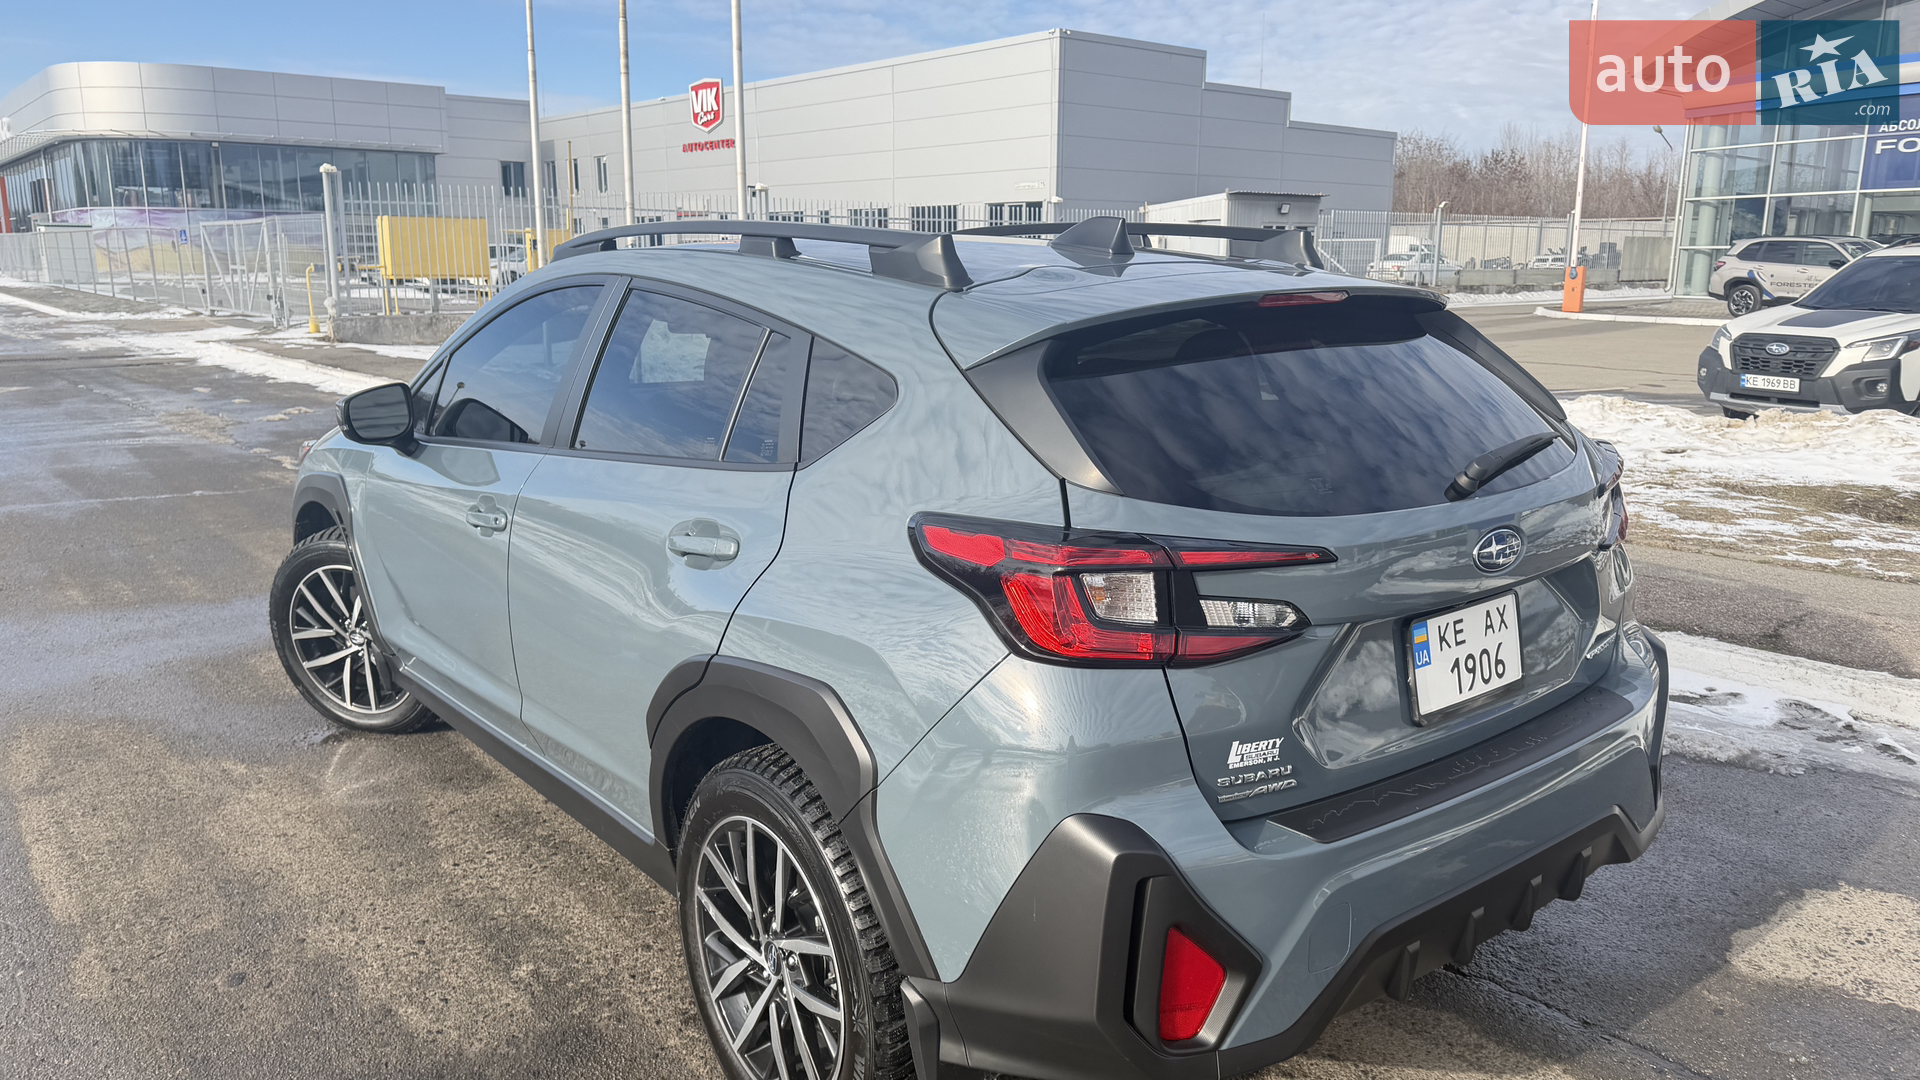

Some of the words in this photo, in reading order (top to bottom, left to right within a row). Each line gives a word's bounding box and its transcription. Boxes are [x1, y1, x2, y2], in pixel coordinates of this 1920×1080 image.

[691, 87, 719, 114] VIK
[698, 111, 716, 126] Cars
[682, 138, 735, 152] AUTOCENTER
[1746, 376, 1758, 386] KE
[1762, 378, 1781, 388] 1969
[1783, 379, 1796, 389] BB
[1438, 618, 1466, 652] KE
[1484, 604, 1508, 637] AX
[1415, 649, 1430, 666] UA
[1450, 642, 1506, 695] 1906
[1227, 737, 1284, 764] LIBERTY
[1217, 765, 1292, 787] SUBARU
[1249, 779, 1297, 797] AWD
